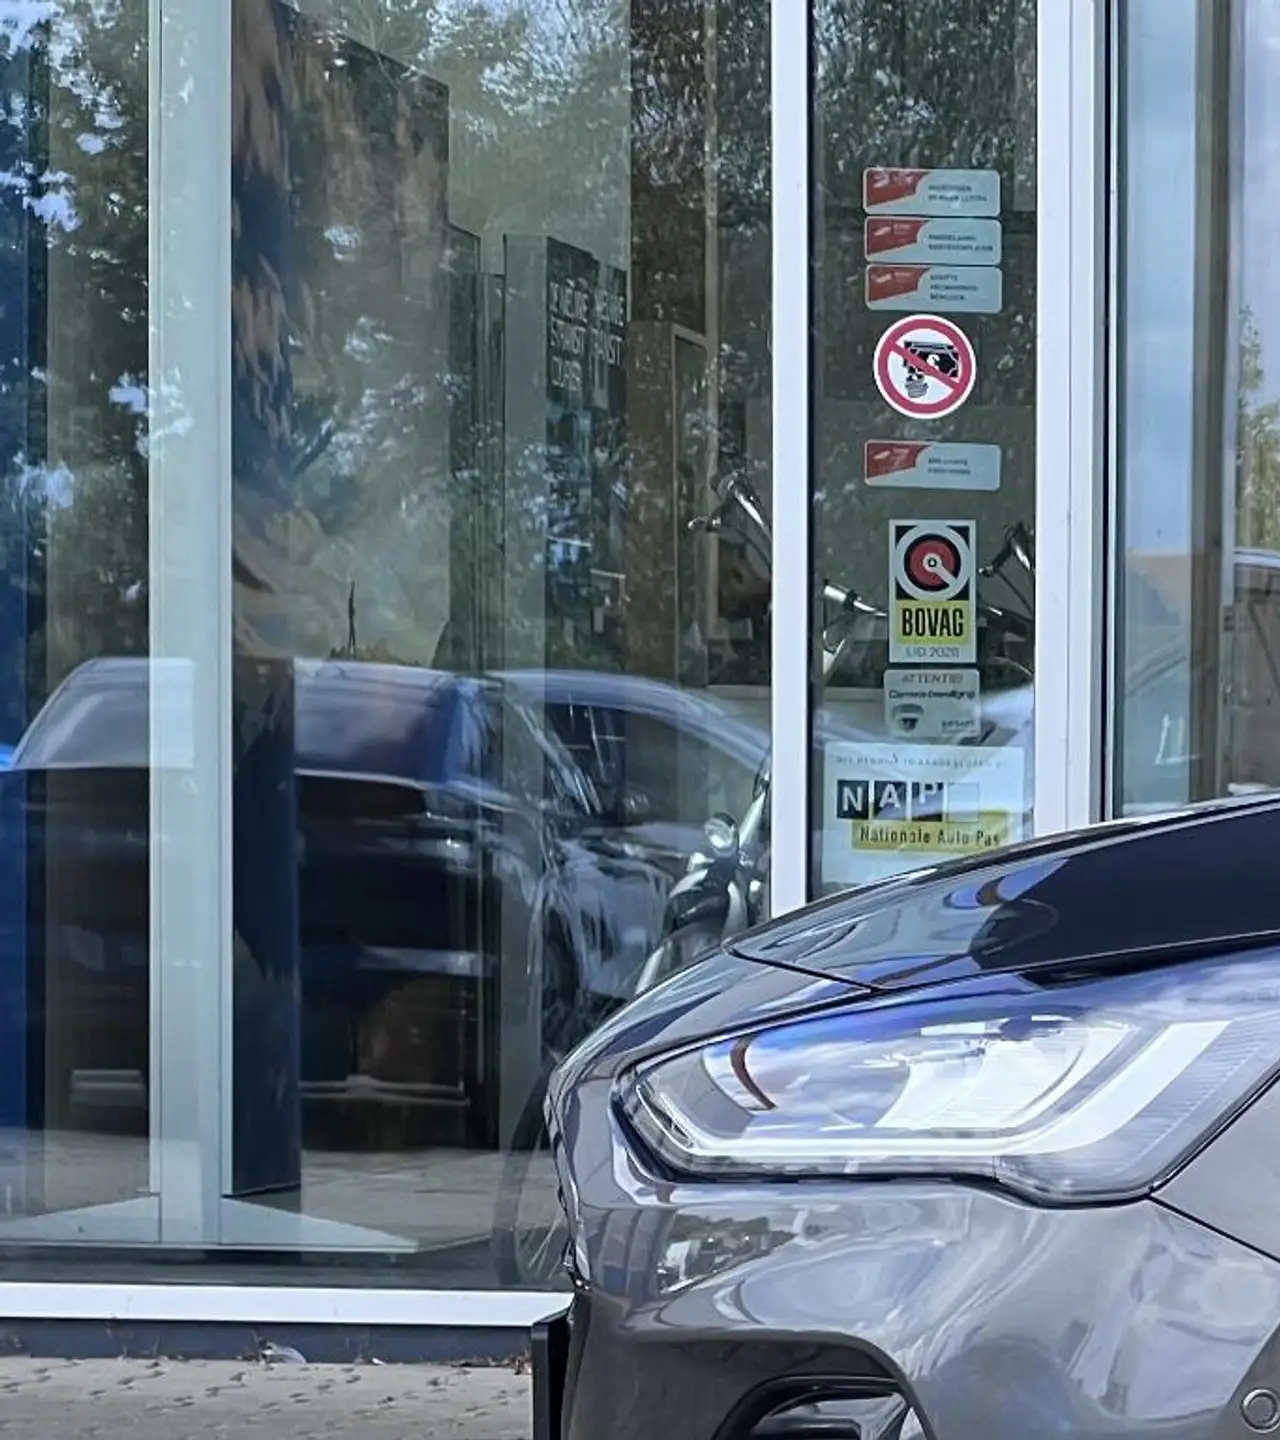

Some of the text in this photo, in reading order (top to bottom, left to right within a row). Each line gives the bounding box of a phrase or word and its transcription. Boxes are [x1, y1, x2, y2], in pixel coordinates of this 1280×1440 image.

[902, 607, 964, 637] BOVAG
[842, 783, 943, 812] NAP
[860, 826, 930, 845] Nationale
[937, 828, 969, 845] Auto
